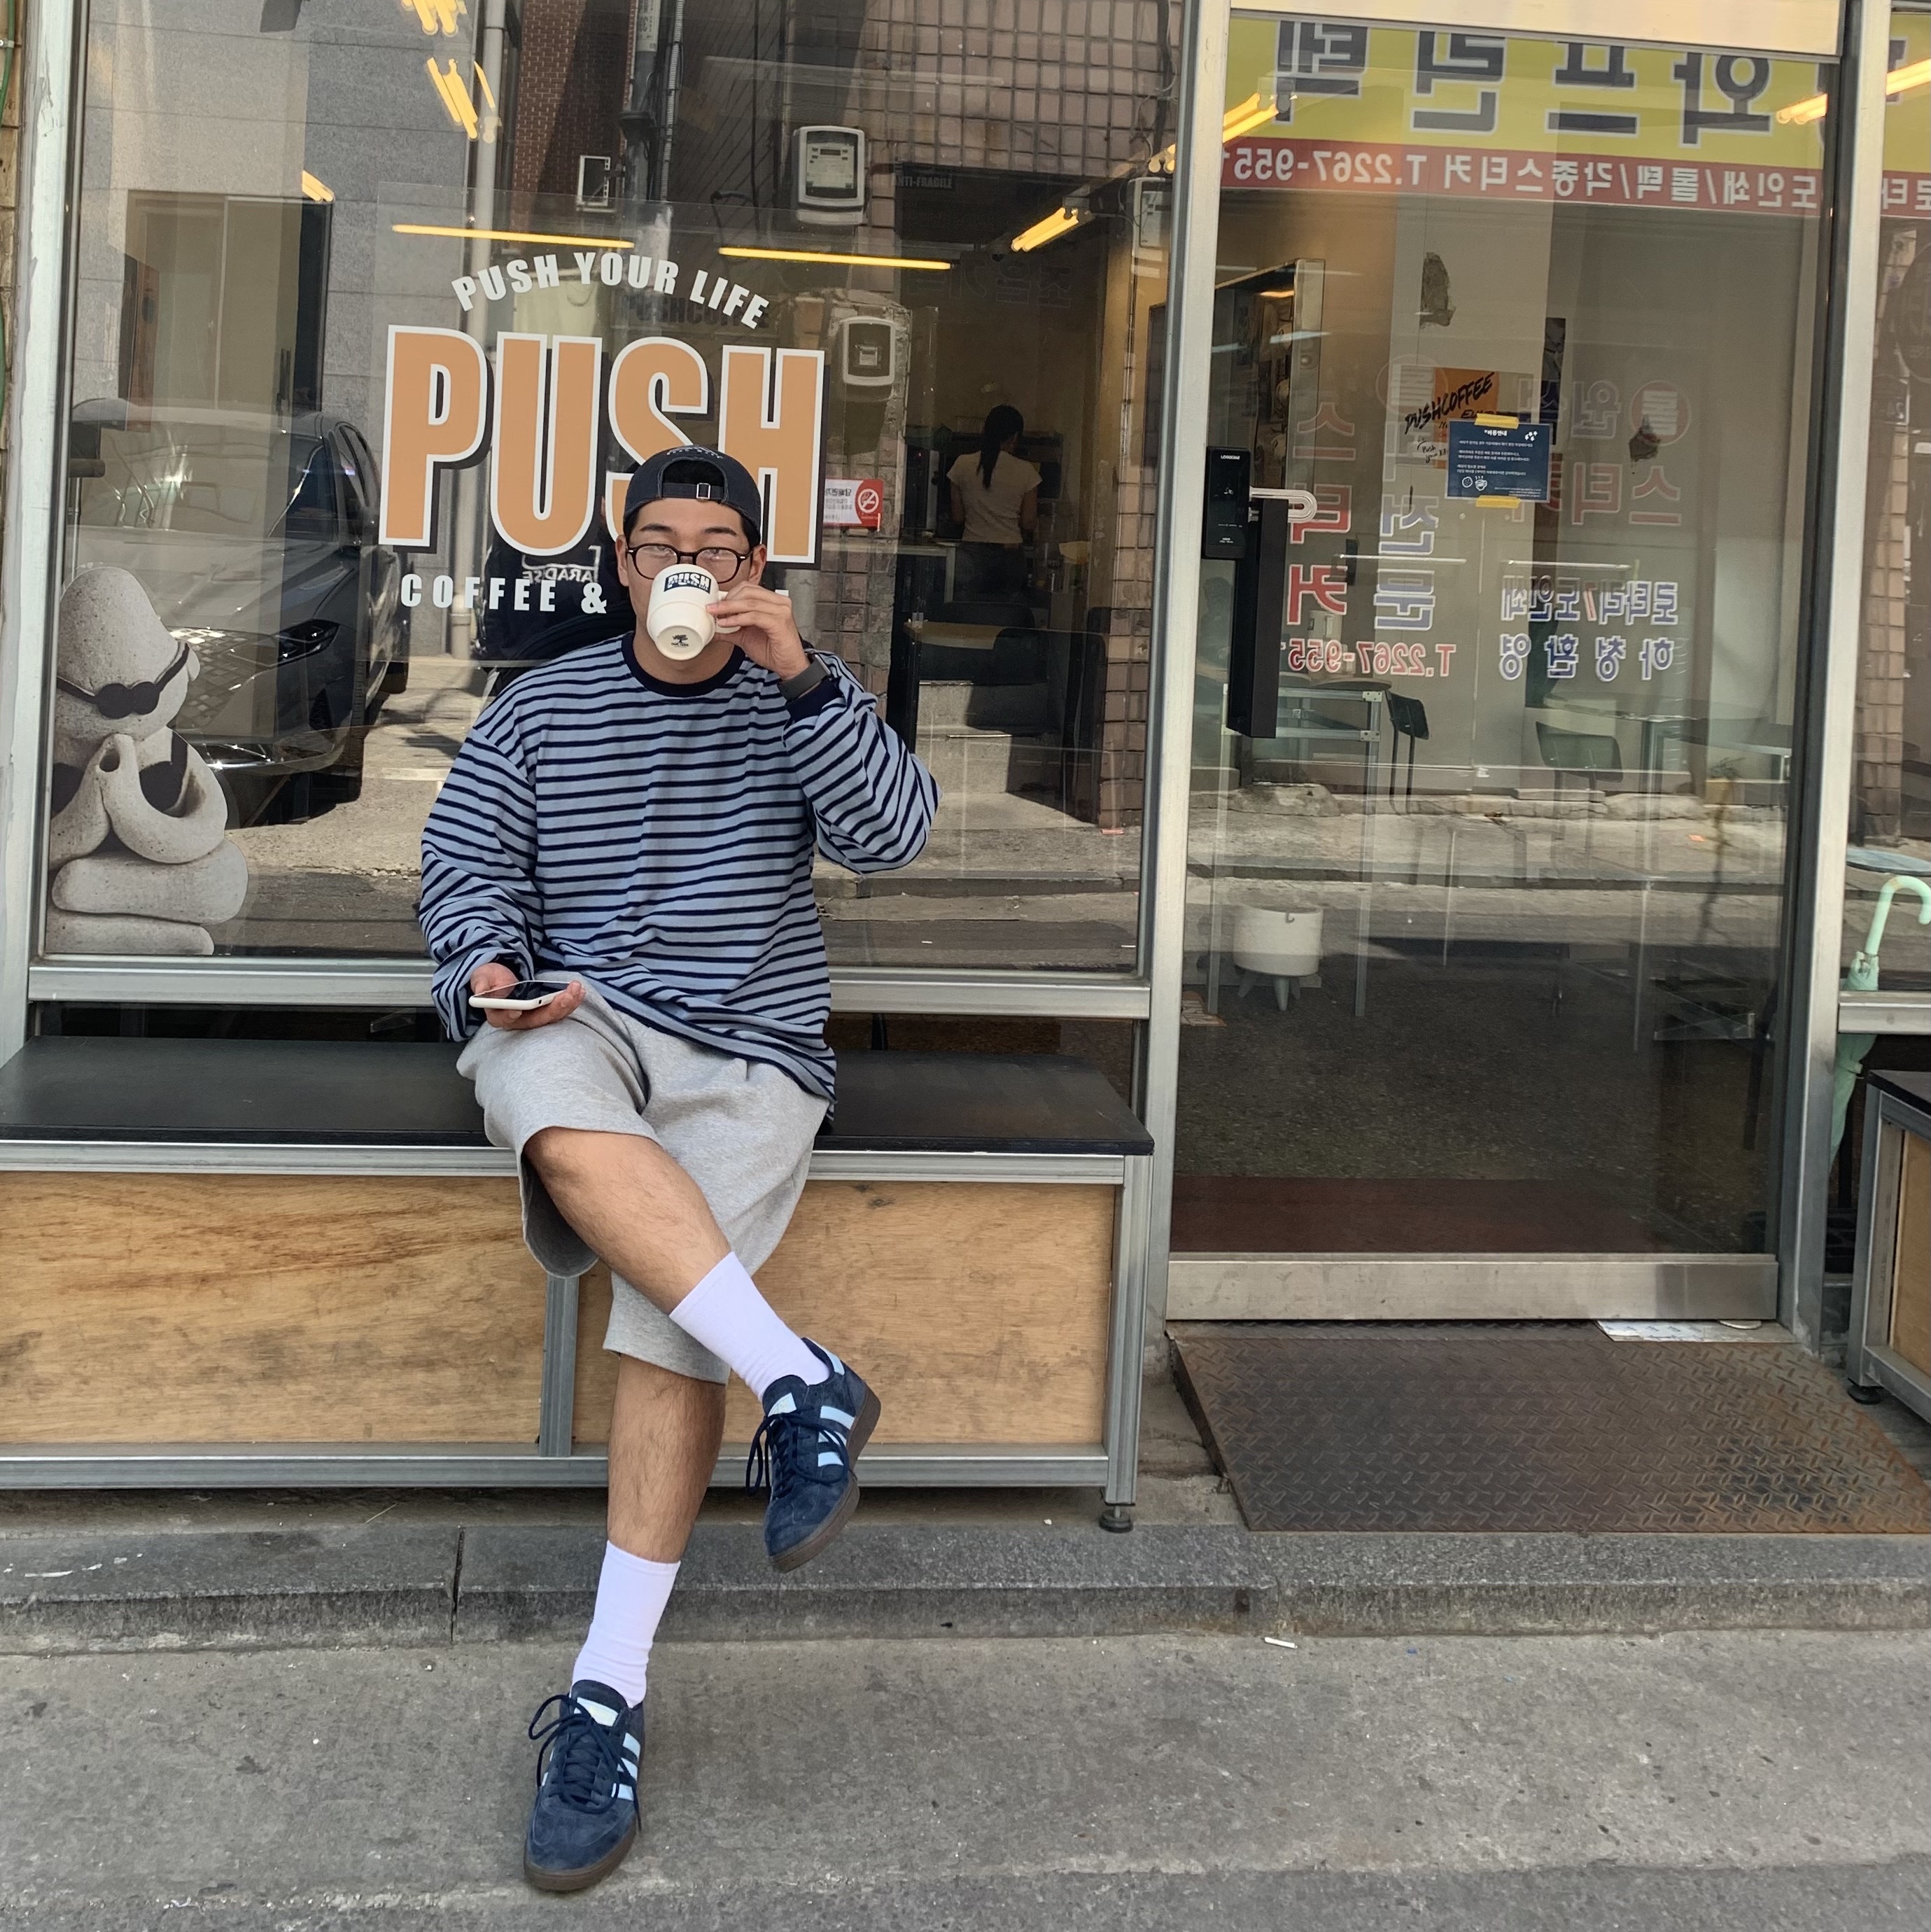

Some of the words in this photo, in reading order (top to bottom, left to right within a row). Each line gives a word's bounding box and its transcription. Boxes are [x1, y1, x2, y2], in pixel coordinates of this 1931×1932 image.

[451, 254, 559, 311] PUSH
[574, 252, 679, 295] YOUR
[689, 270, 769, 329] LIFE
[379, 325, 826, 566] PUSH
[401, 574, 556, 611] COFFEE
[582, 582, 607, 614] &
[668, 573, 710, 589] PUSH
